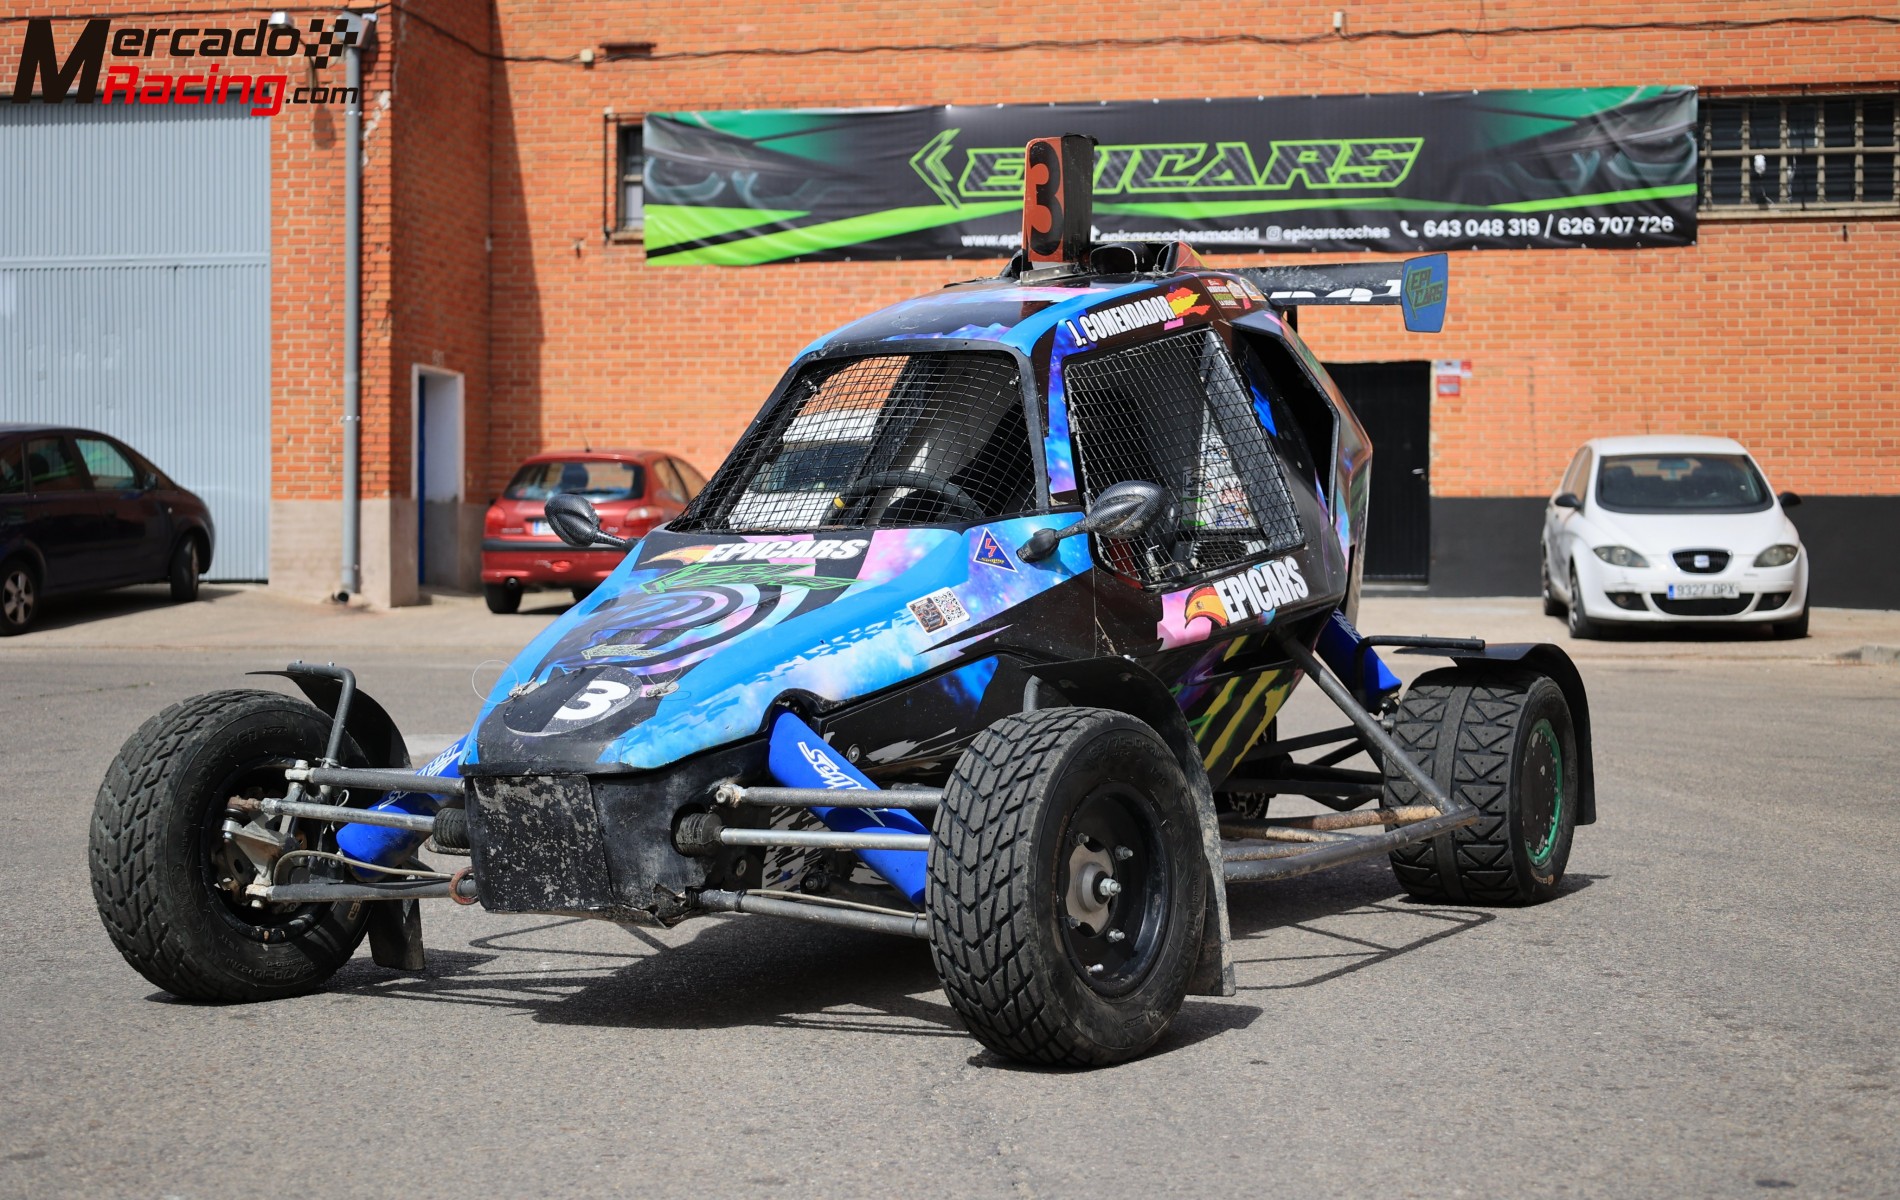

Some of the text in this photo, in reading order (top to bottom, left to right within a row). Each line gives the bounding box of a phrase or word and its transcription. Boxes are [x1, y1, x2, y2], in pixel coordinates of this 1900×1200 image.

[957, 137, 1425, 196] EICARS
[1028, 141, 1065, 255] 3
[960, 231, 1023, 249] www.epi
[1283, 225, 1391, 244] epicarscoches
[1423, 219, 1462, 238] 643
[1465, 218, 1504, 238] 048
[1507, 217, 1540, 236] 319
[1558, 217, 1595, 235] 626
[1598, 216, 1634, 235] 707
[1638, 216, 1675, 234] 726
[1410, 269, 1431, 291] EPI
[1412, 282, 1443, 309] CARS
[1065, 295, 1177, 348] J. COMENDADOR
[697, 538, 870, 563] EPICARS
[1212, 555, 1310, 625] EPICARS
[1676, 584, 1707, 596] 9327
[553, 680, 631, 720] 3
